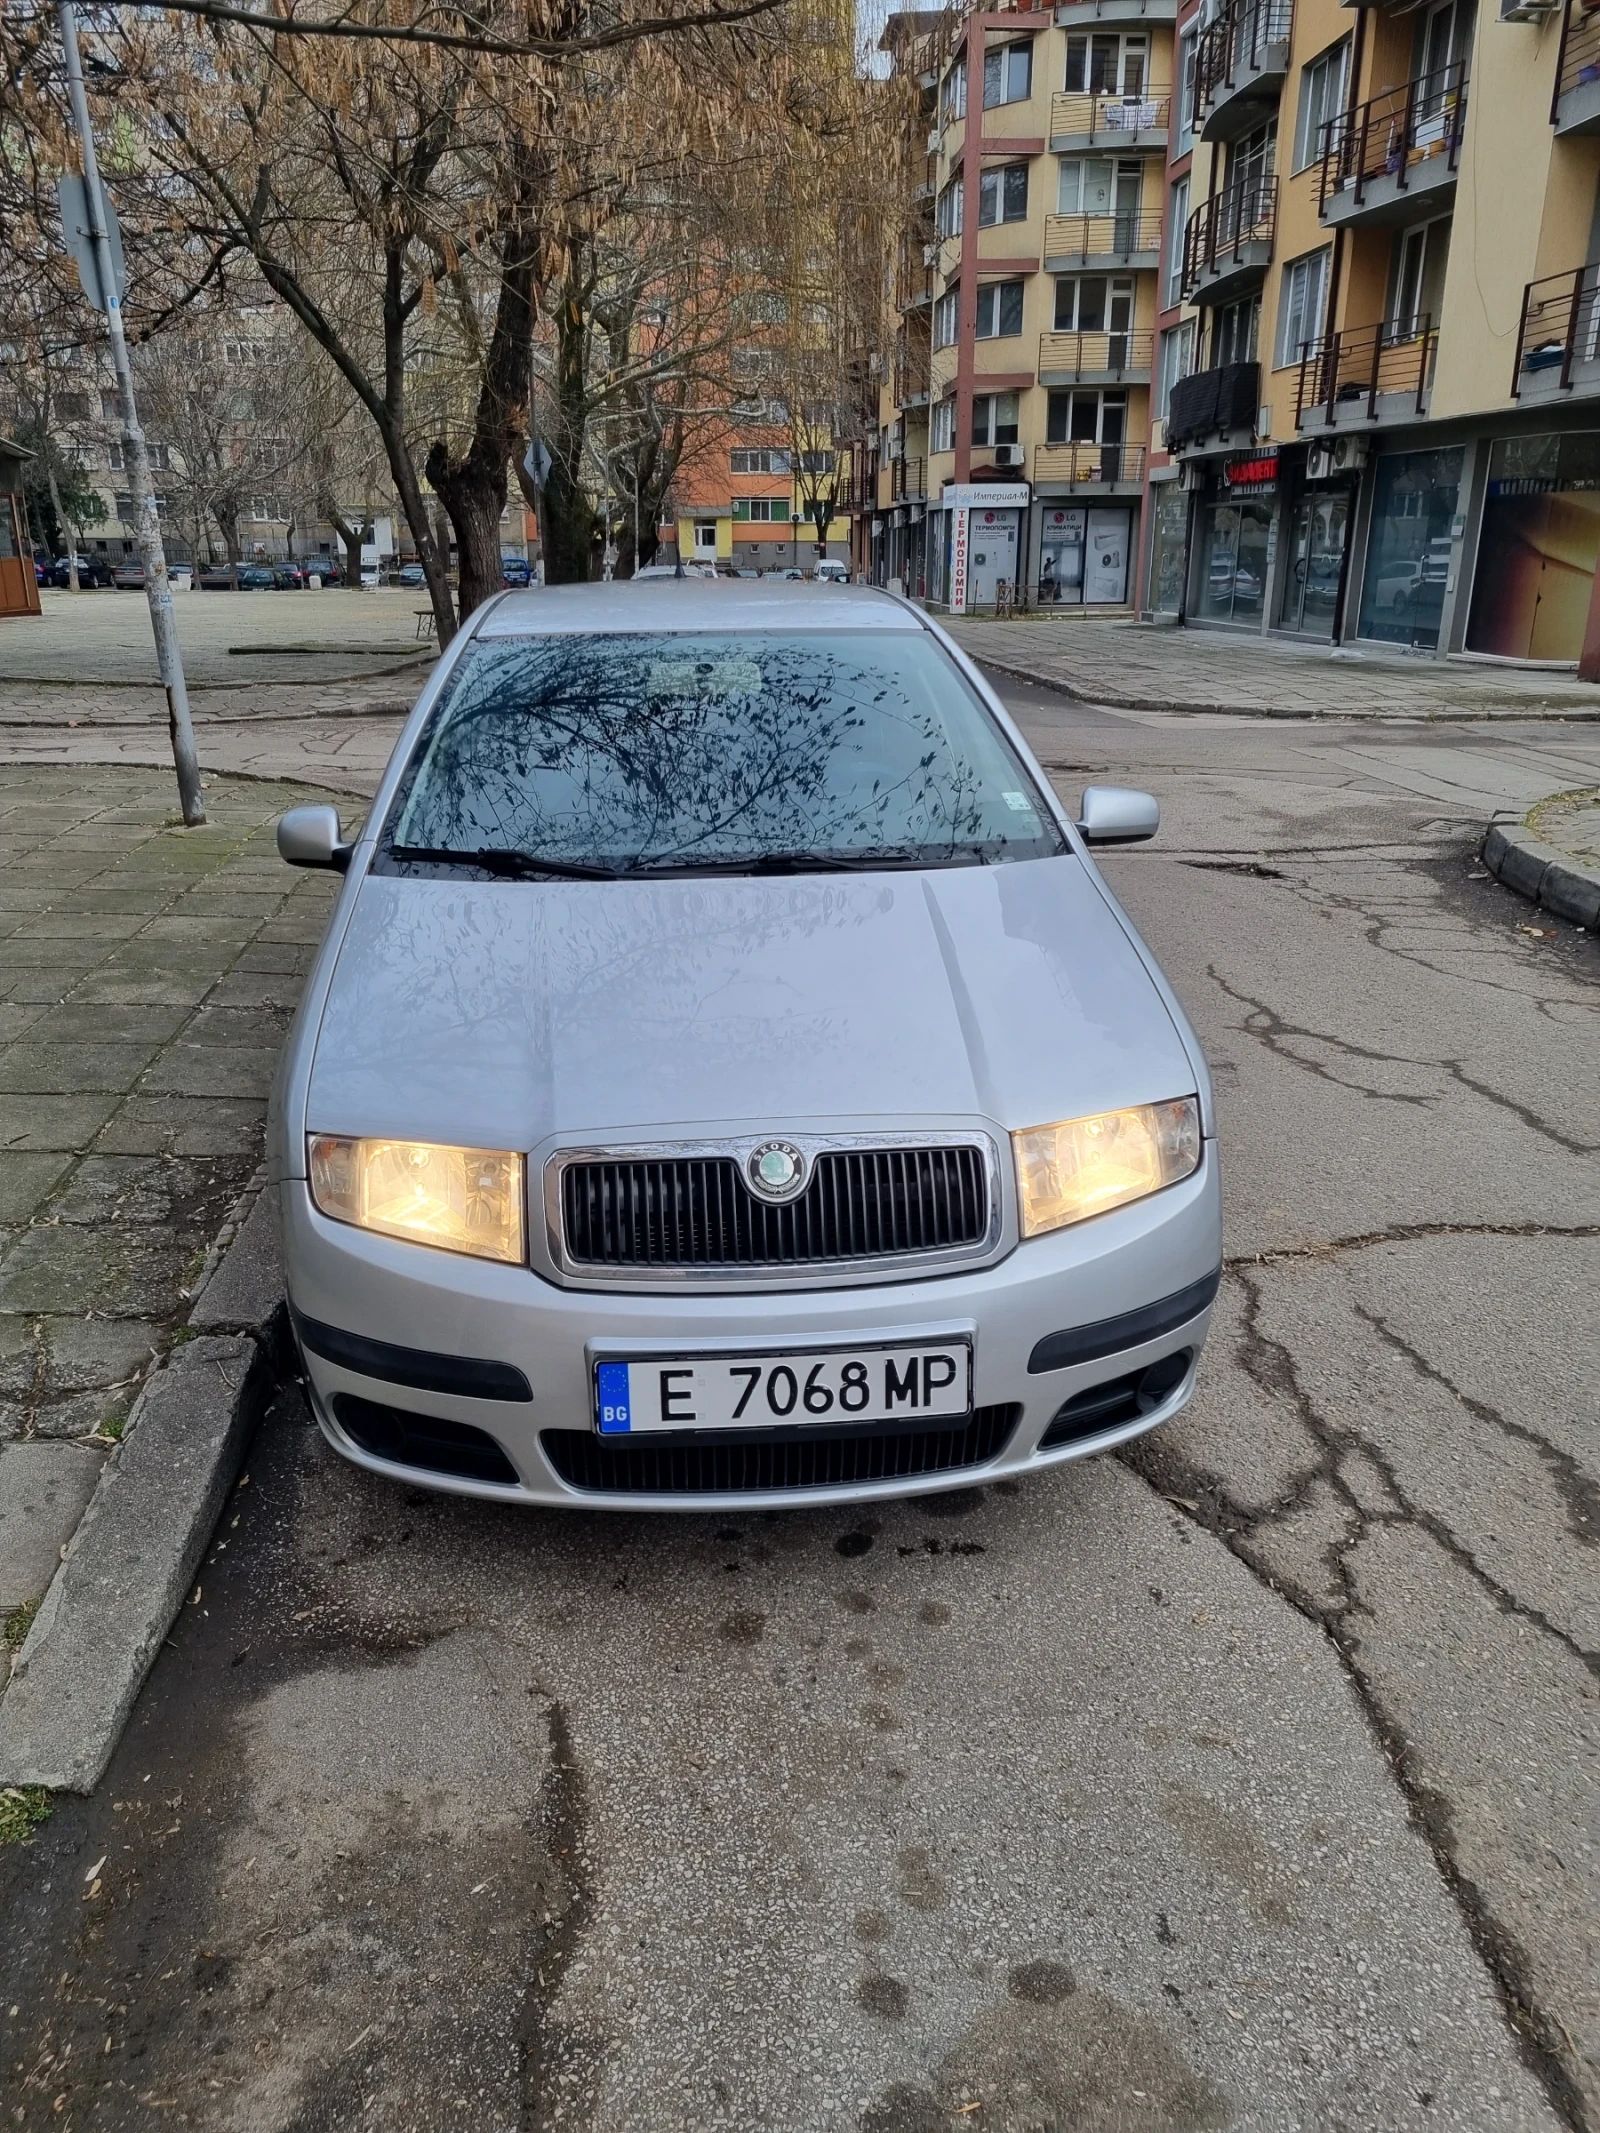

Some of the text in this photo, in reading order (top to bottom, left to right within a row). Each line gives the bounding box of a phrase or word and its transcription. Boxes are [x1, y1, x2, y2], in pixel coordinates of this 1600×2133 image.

[974, 491, 1027, 502] Империал-М
[955, 510, 966, 605] ТЕРМОПОМПИ
[753, 1143, 799, 1161] SKODA
[729, 1361, 870, 1419] 7068
[603, 1405, 627, 1422] BG
